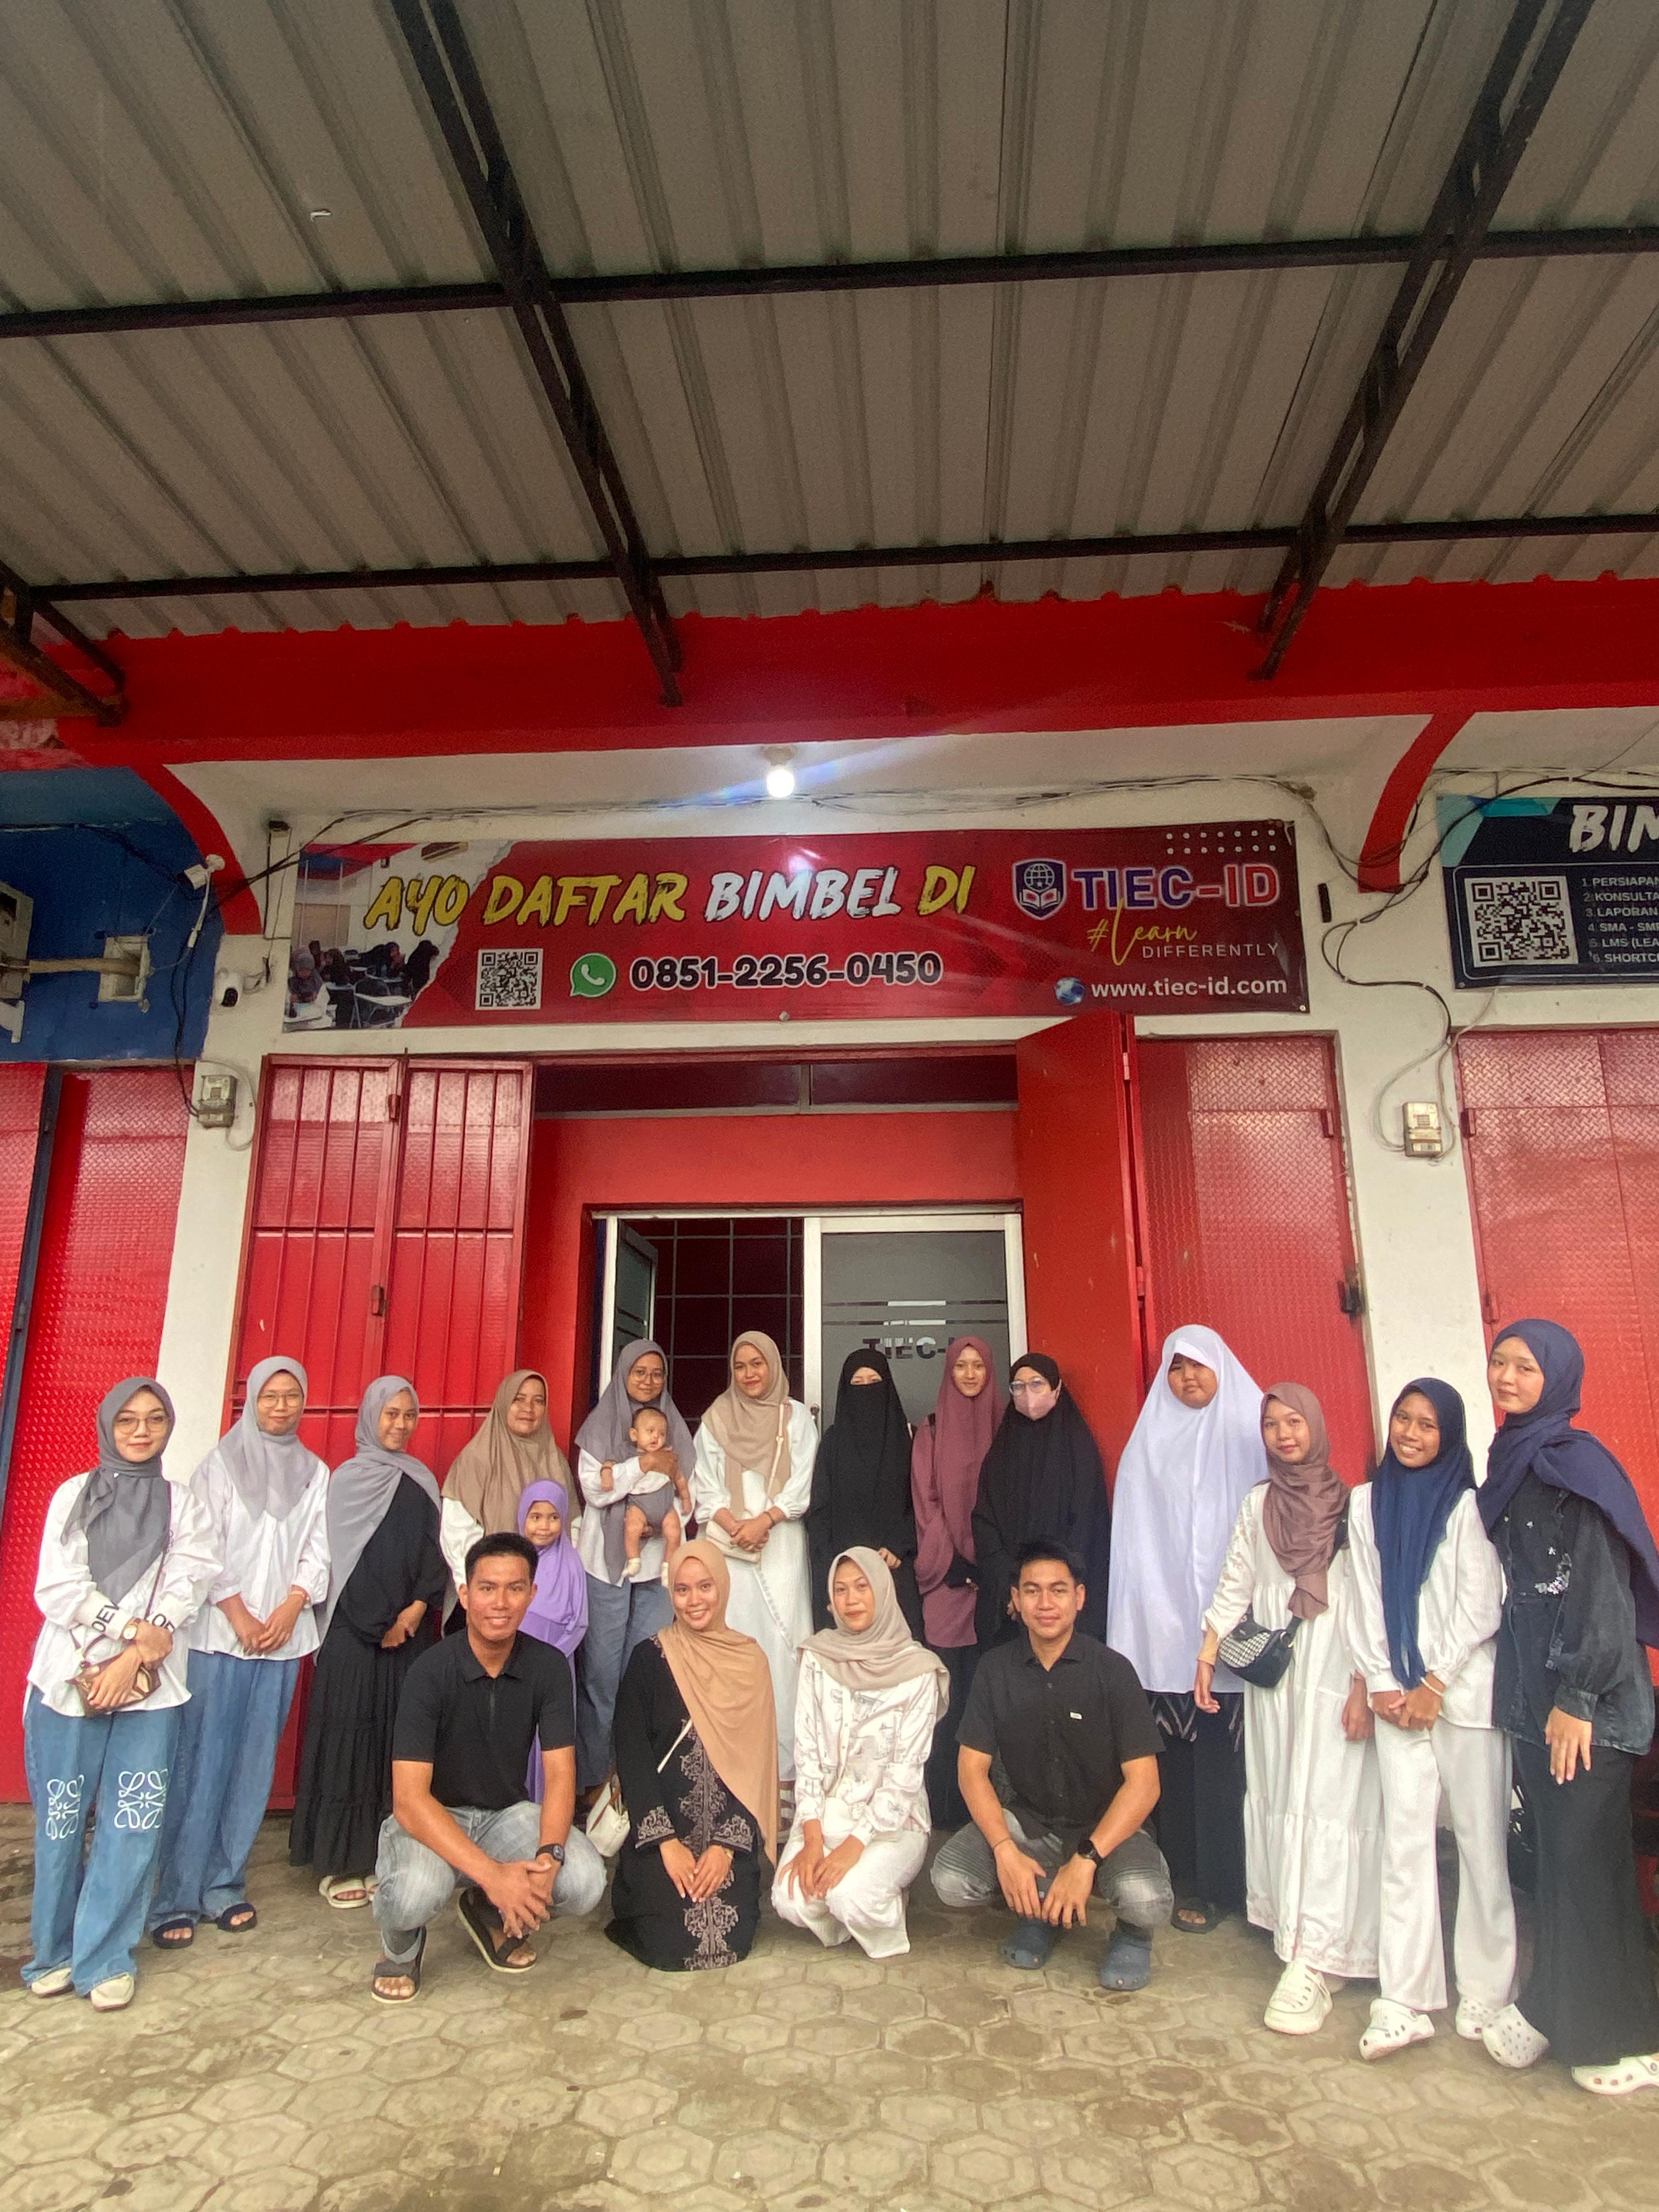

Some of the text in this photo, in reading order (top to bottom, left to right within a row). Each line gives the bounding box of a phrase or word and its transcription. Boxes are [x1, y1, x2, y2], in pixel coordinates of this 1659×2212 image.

[1071, 863, 1280, 910] TIEC-ID
[363, 865, 975, 936] AYO DAFTAR BIMBEL DI
[1597, 907, 1657, 917] LAPORAN
[1599, 922, 1628, 932] SMA
[1142, 942, 1278, 958] DIFFERENTLY
[1602, 939, 1628, 947] LMS
[629, 952, 943, 991] 0851-2256-0450
[1091, 976, 1287, 997] www.tiec-id.com
